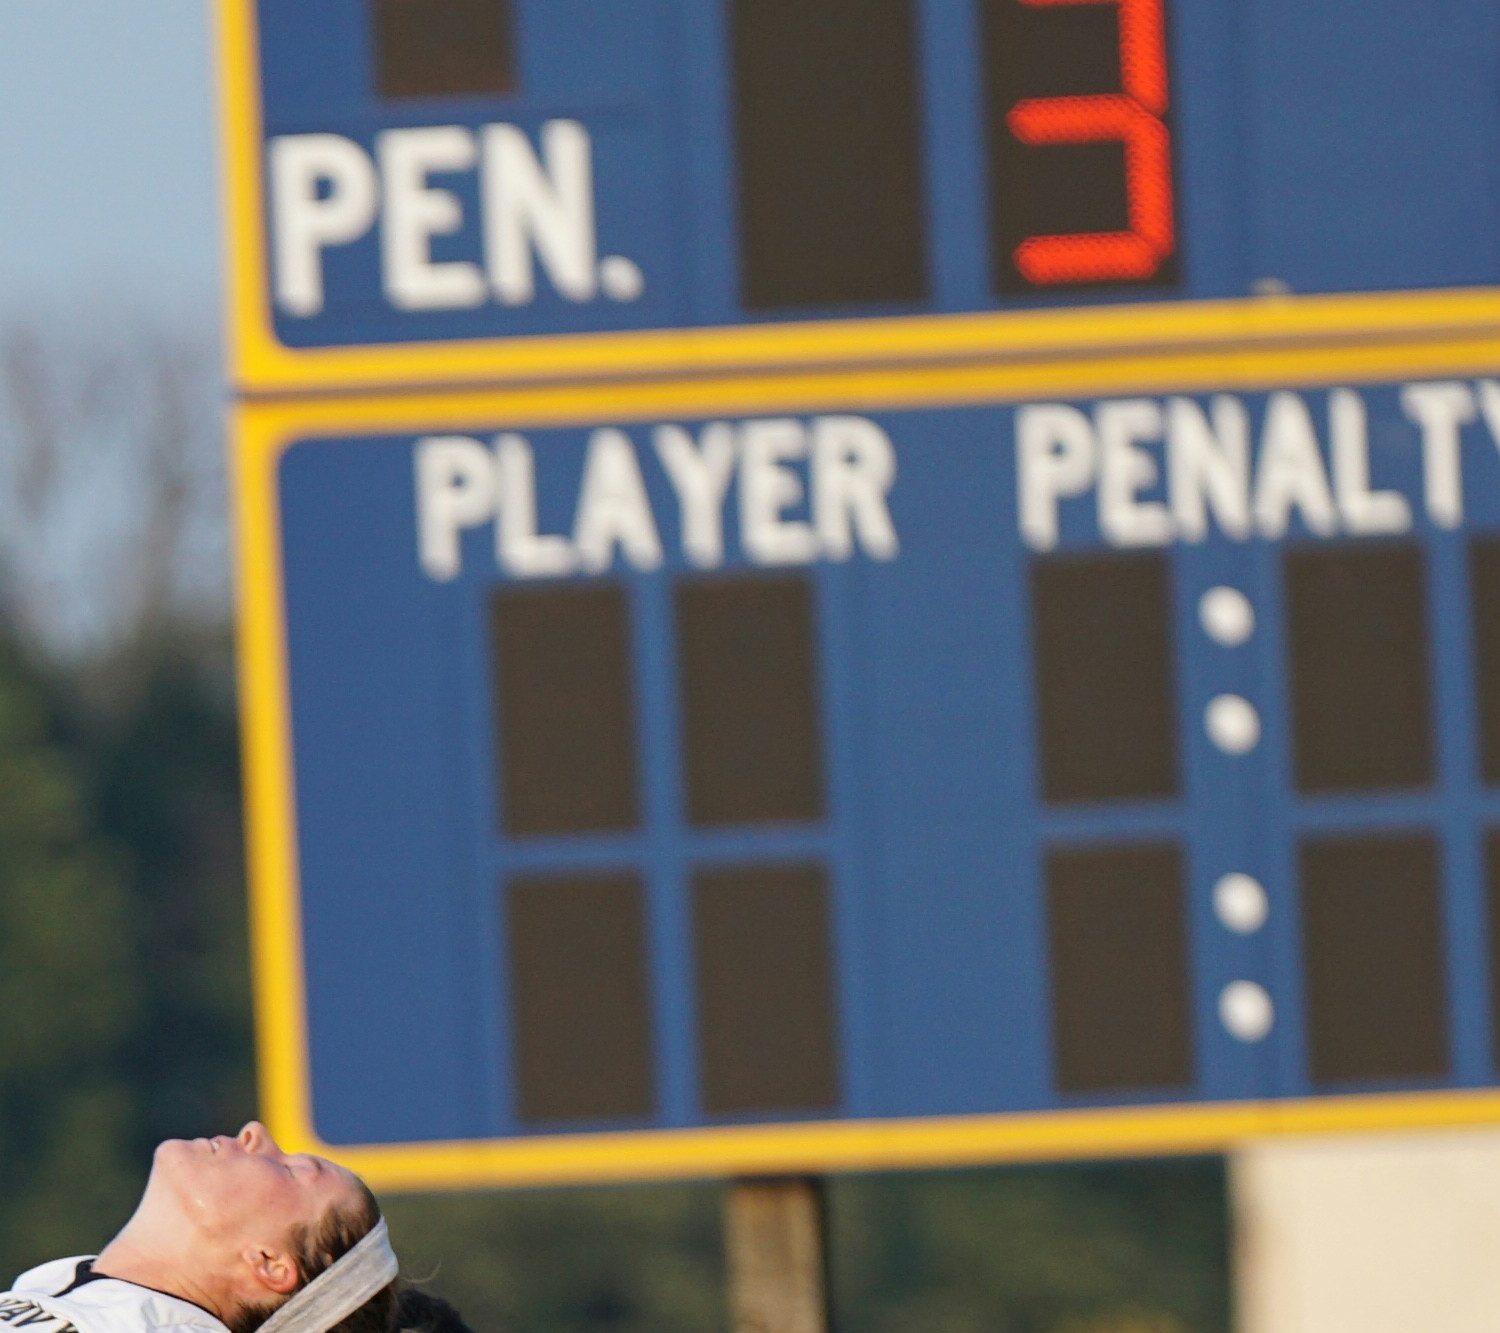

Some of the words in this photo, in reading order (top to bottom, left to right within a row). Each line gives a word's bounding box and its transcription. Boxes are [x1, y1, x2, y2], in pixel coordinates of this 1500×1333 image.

[262, 118, 645, 318] PEN.
[1007, 0, 1176, 285] 3
[413, 413, 900, 581] PLAYER
